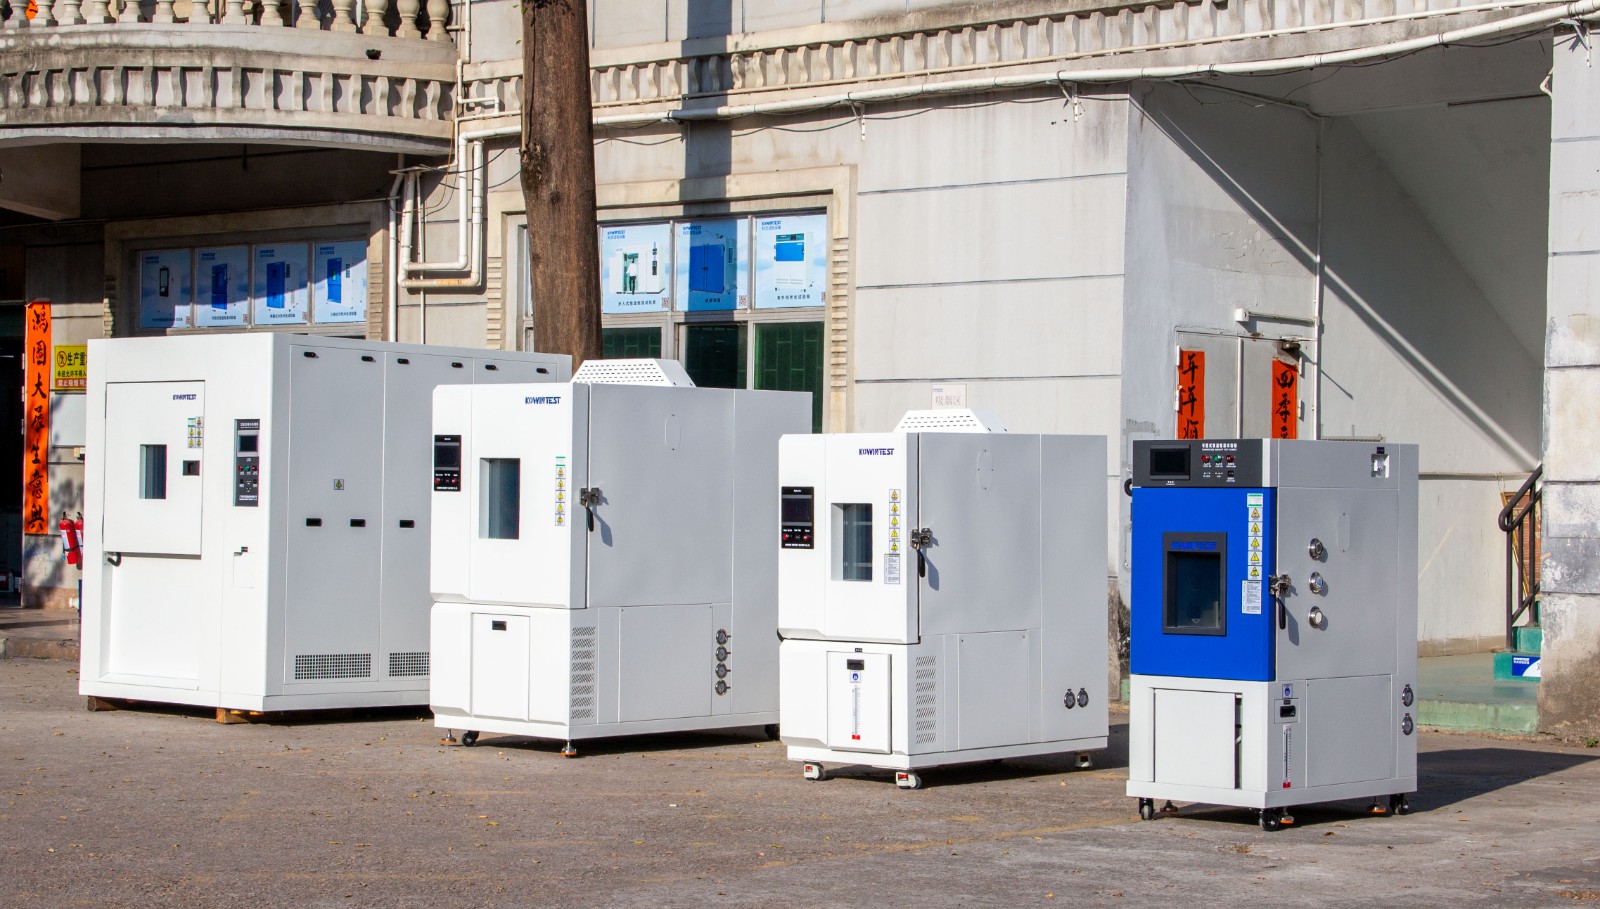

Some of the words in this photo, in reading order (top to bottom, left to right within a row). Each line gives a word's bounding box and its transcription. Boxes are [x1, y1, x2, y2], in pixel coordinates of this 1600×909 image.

[67, 352, 87, 366] 生产重
[525, 396, 561, 404] KOWINTEST
[858, 448, 894, 456] KOWINTEST
